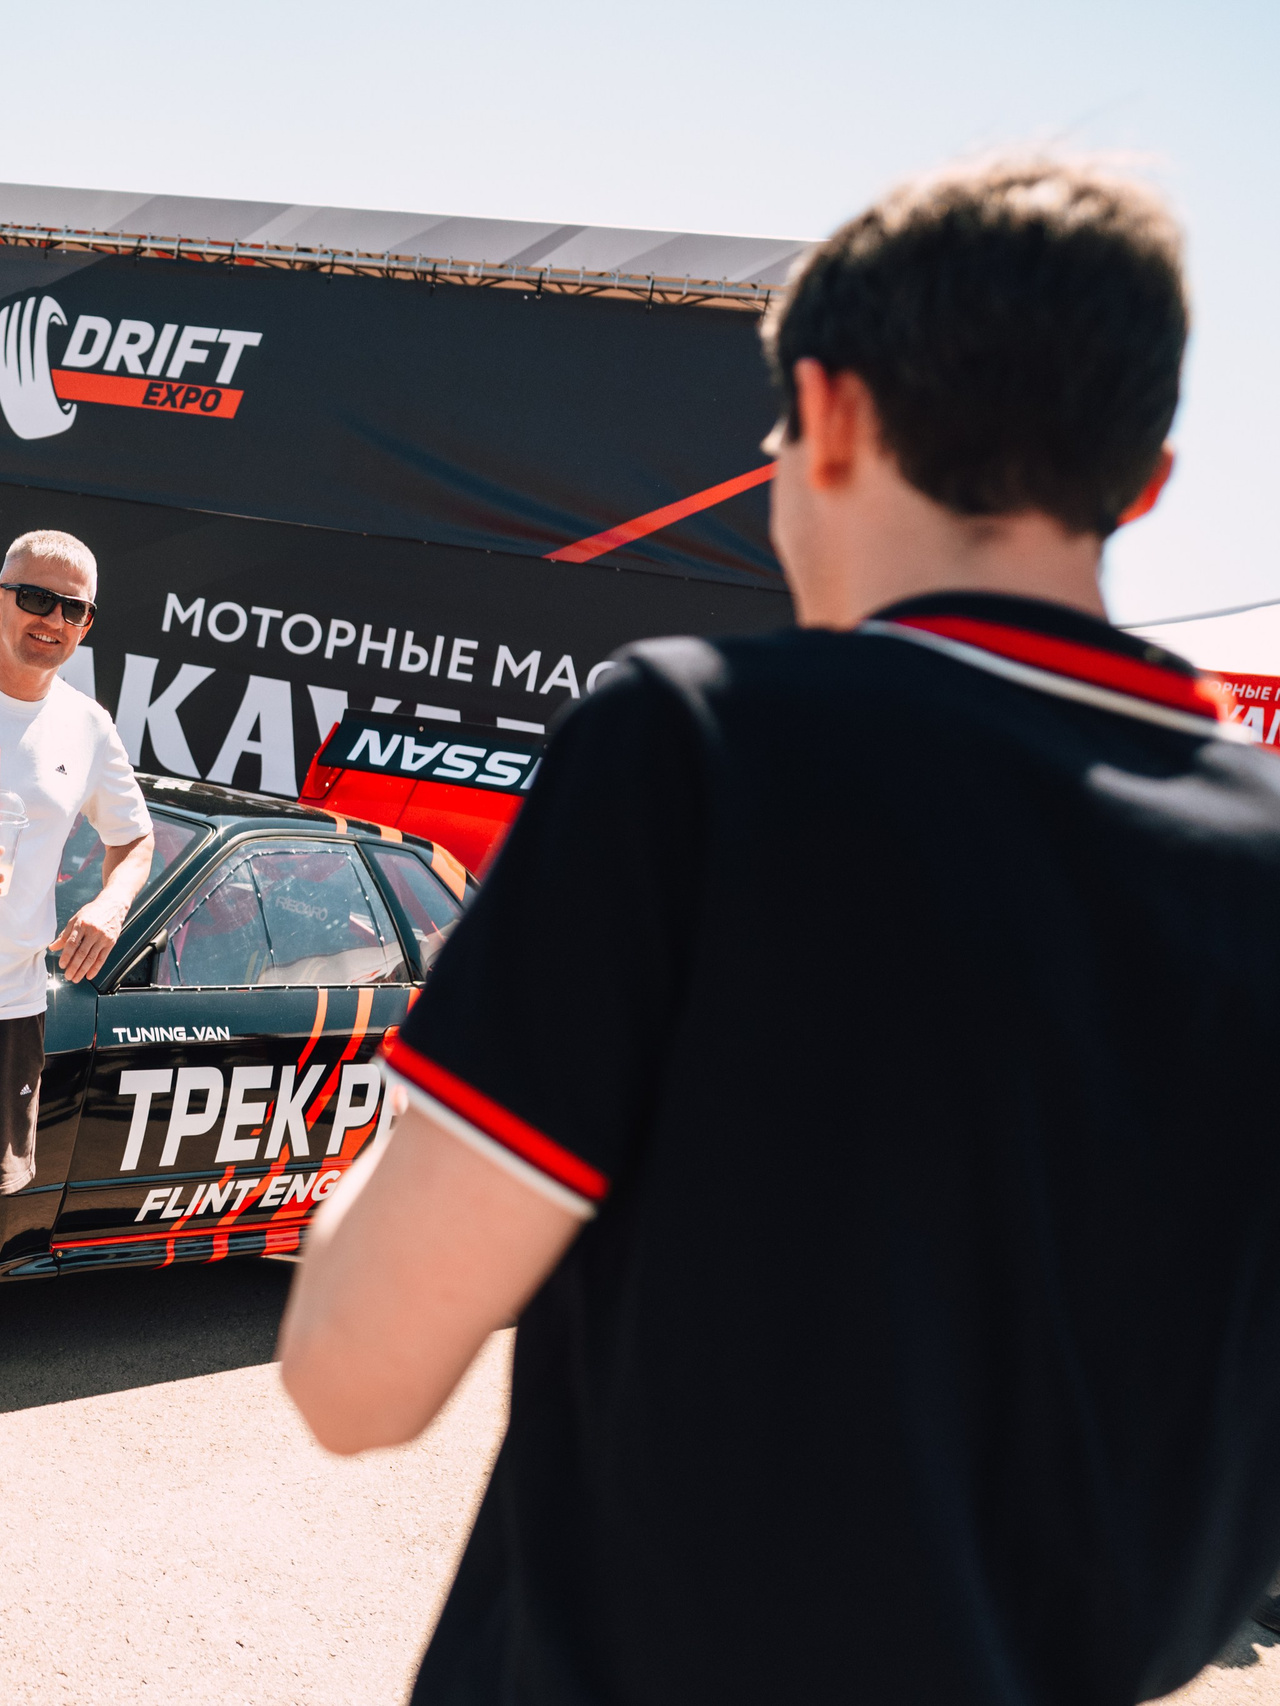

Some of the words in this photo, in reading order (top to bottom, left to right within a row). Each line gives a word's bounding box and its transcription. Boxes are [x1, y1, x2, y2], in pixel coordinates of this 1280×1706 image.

[61, 314, 263, 385] DRIFT
[141, 382, 222, 413] EXPO
[161, 592, 479, 683] МОТОРНЫЕ
[492, 644, 619, 699] МАС
[119, 1063, 327, 1172] ТРЕК
[134, 1178, 261, 1222] FLINT
